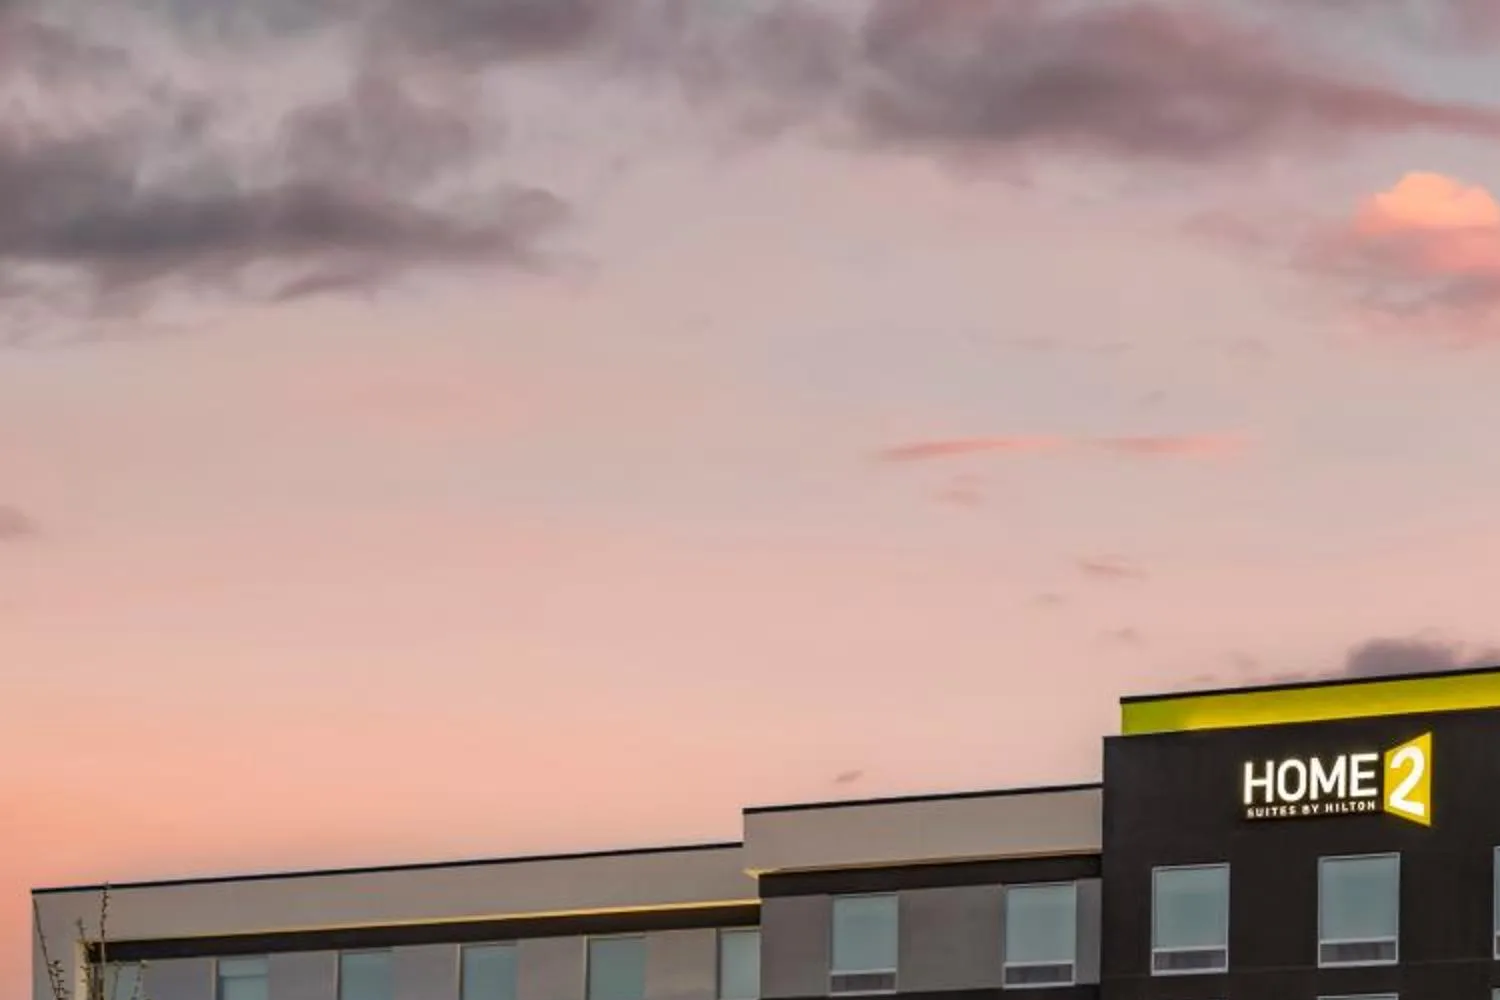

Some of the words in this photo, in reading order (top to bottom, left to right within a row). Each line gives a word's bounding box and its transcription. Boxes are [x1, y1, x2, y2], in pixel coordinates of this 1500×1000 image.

[1243, 752, 1379, 804] HOME
[1389, 746, 1425, 816] 2
[1247, 804, 1297, 818] SUITES
[1302, 803, 1319, 815] BY
[1325, 800, 1376, 813] HILTON
